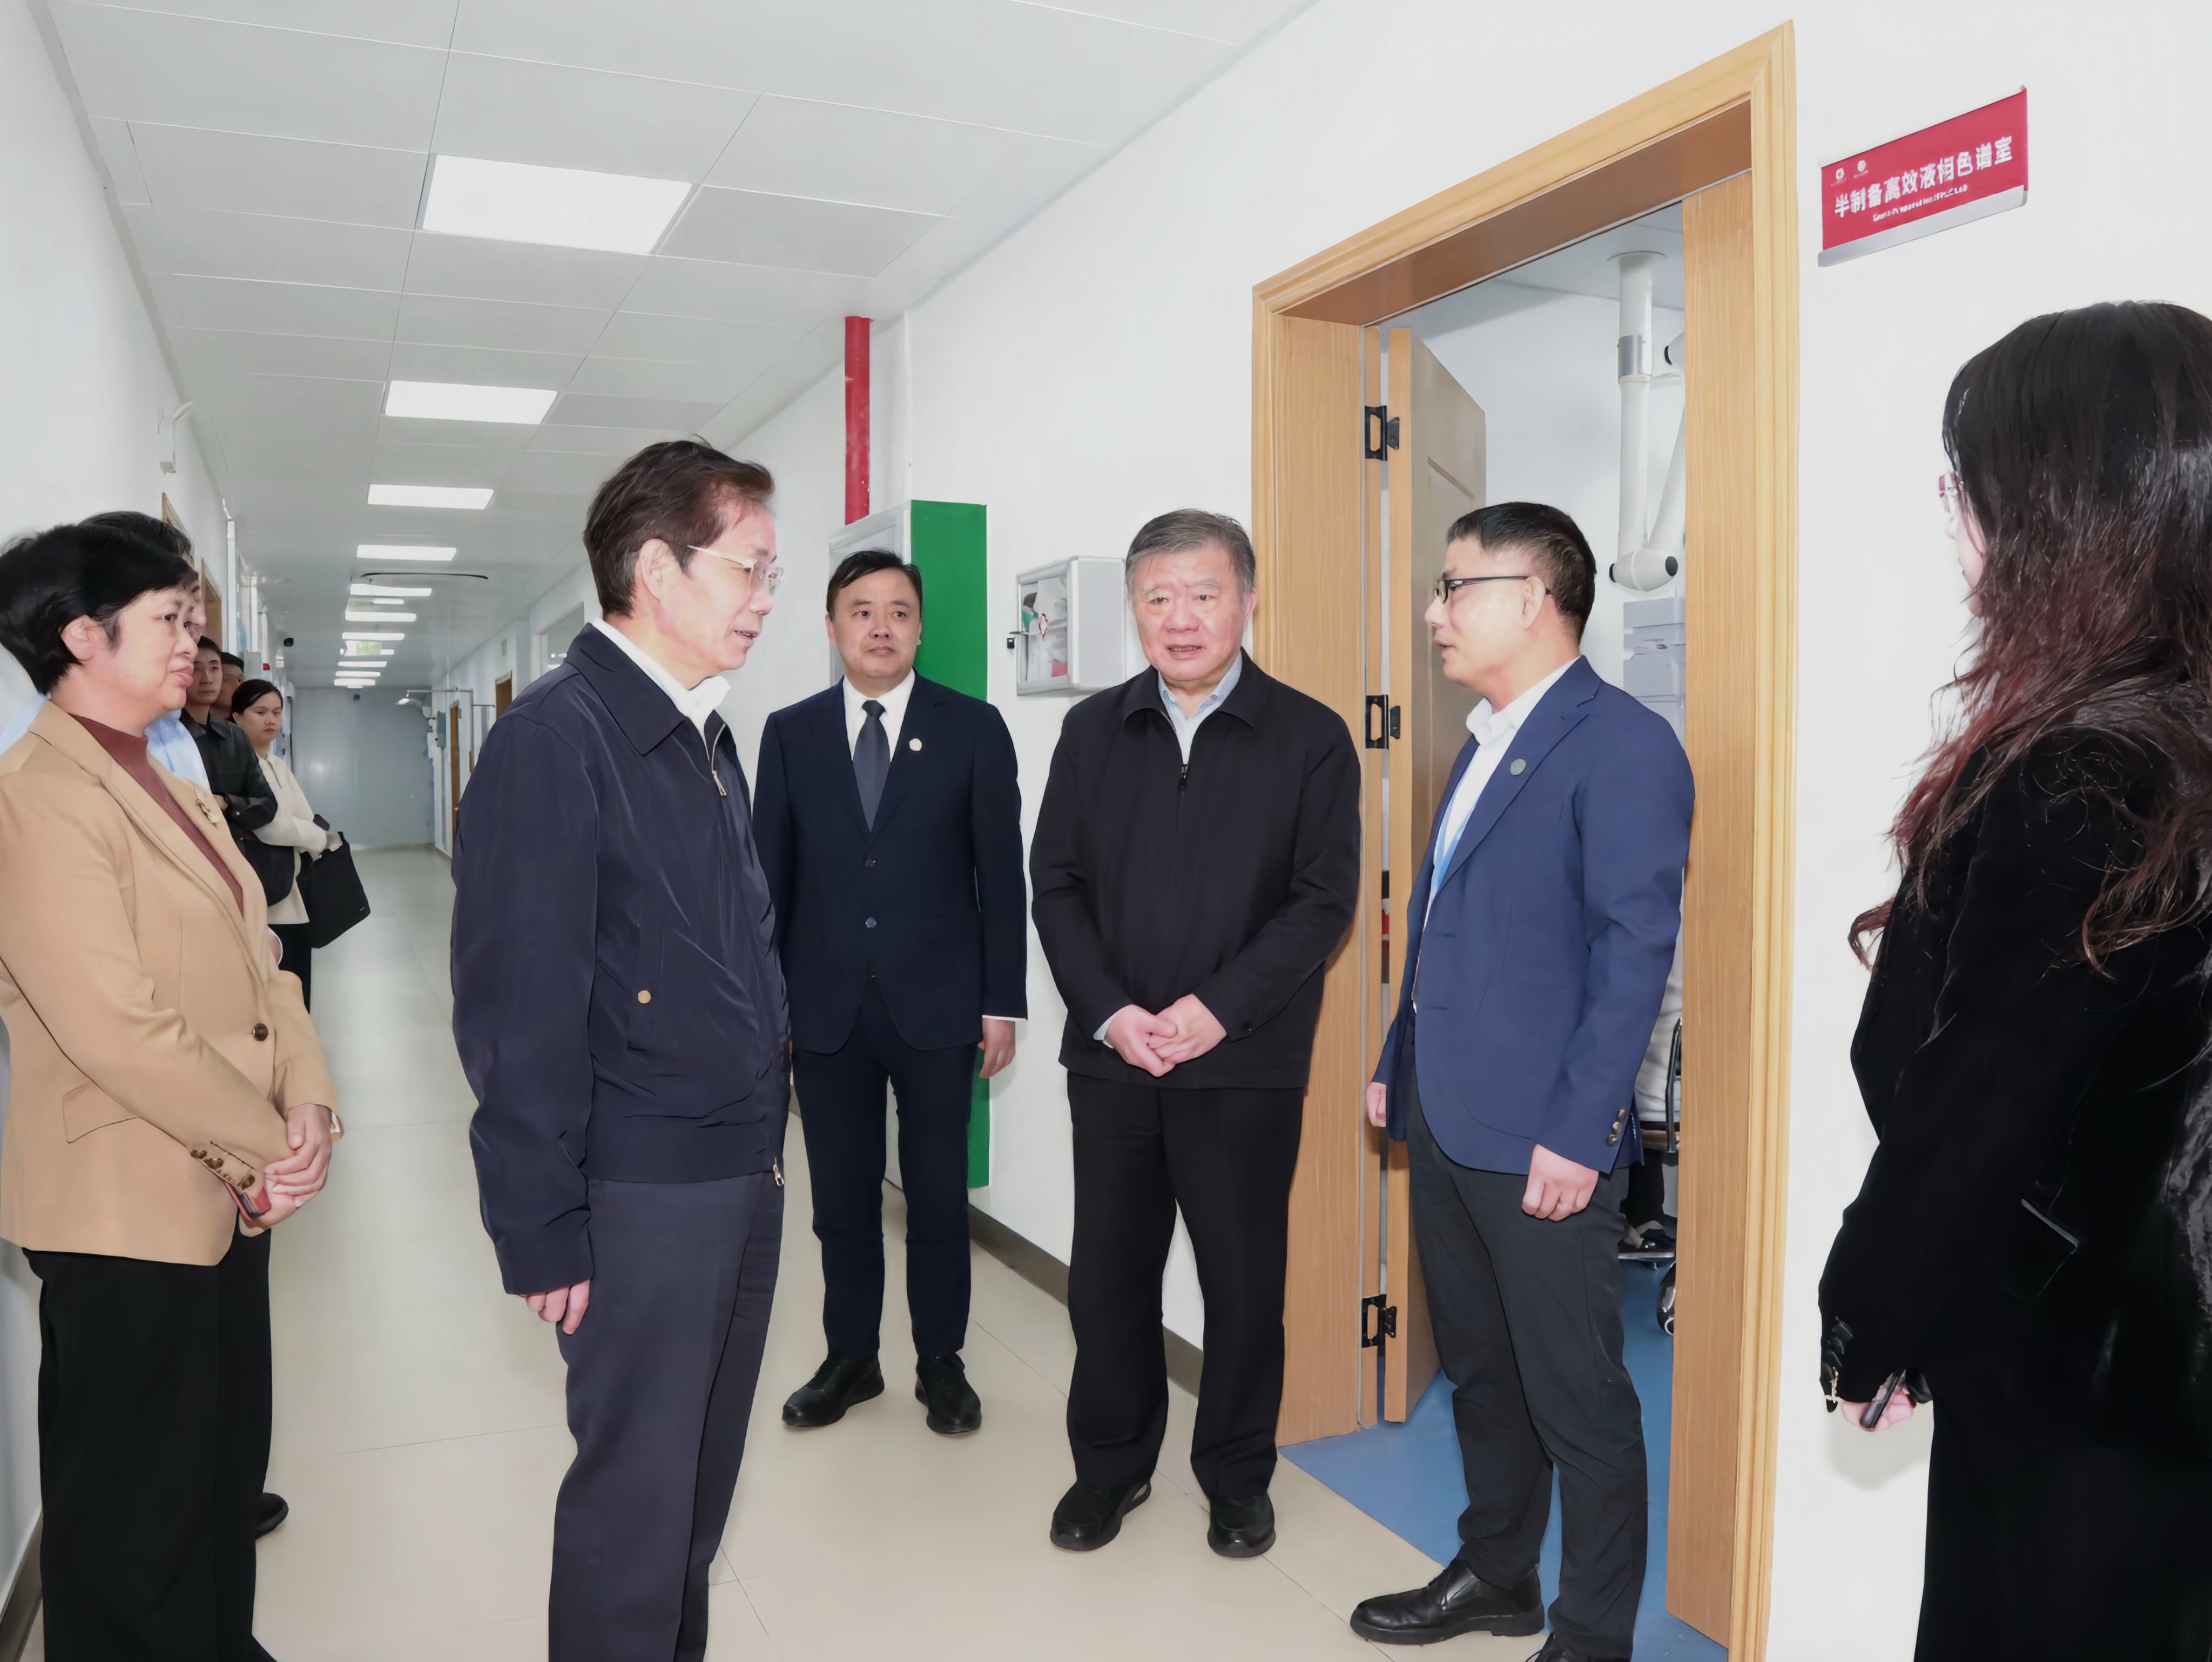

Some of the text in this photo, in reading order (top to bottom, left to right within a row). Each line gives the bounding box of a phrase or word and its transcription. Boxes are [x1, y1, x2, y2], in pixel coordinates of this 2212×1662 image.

[1835, 136, 2012, 218] 半制备高效液相色谱室
